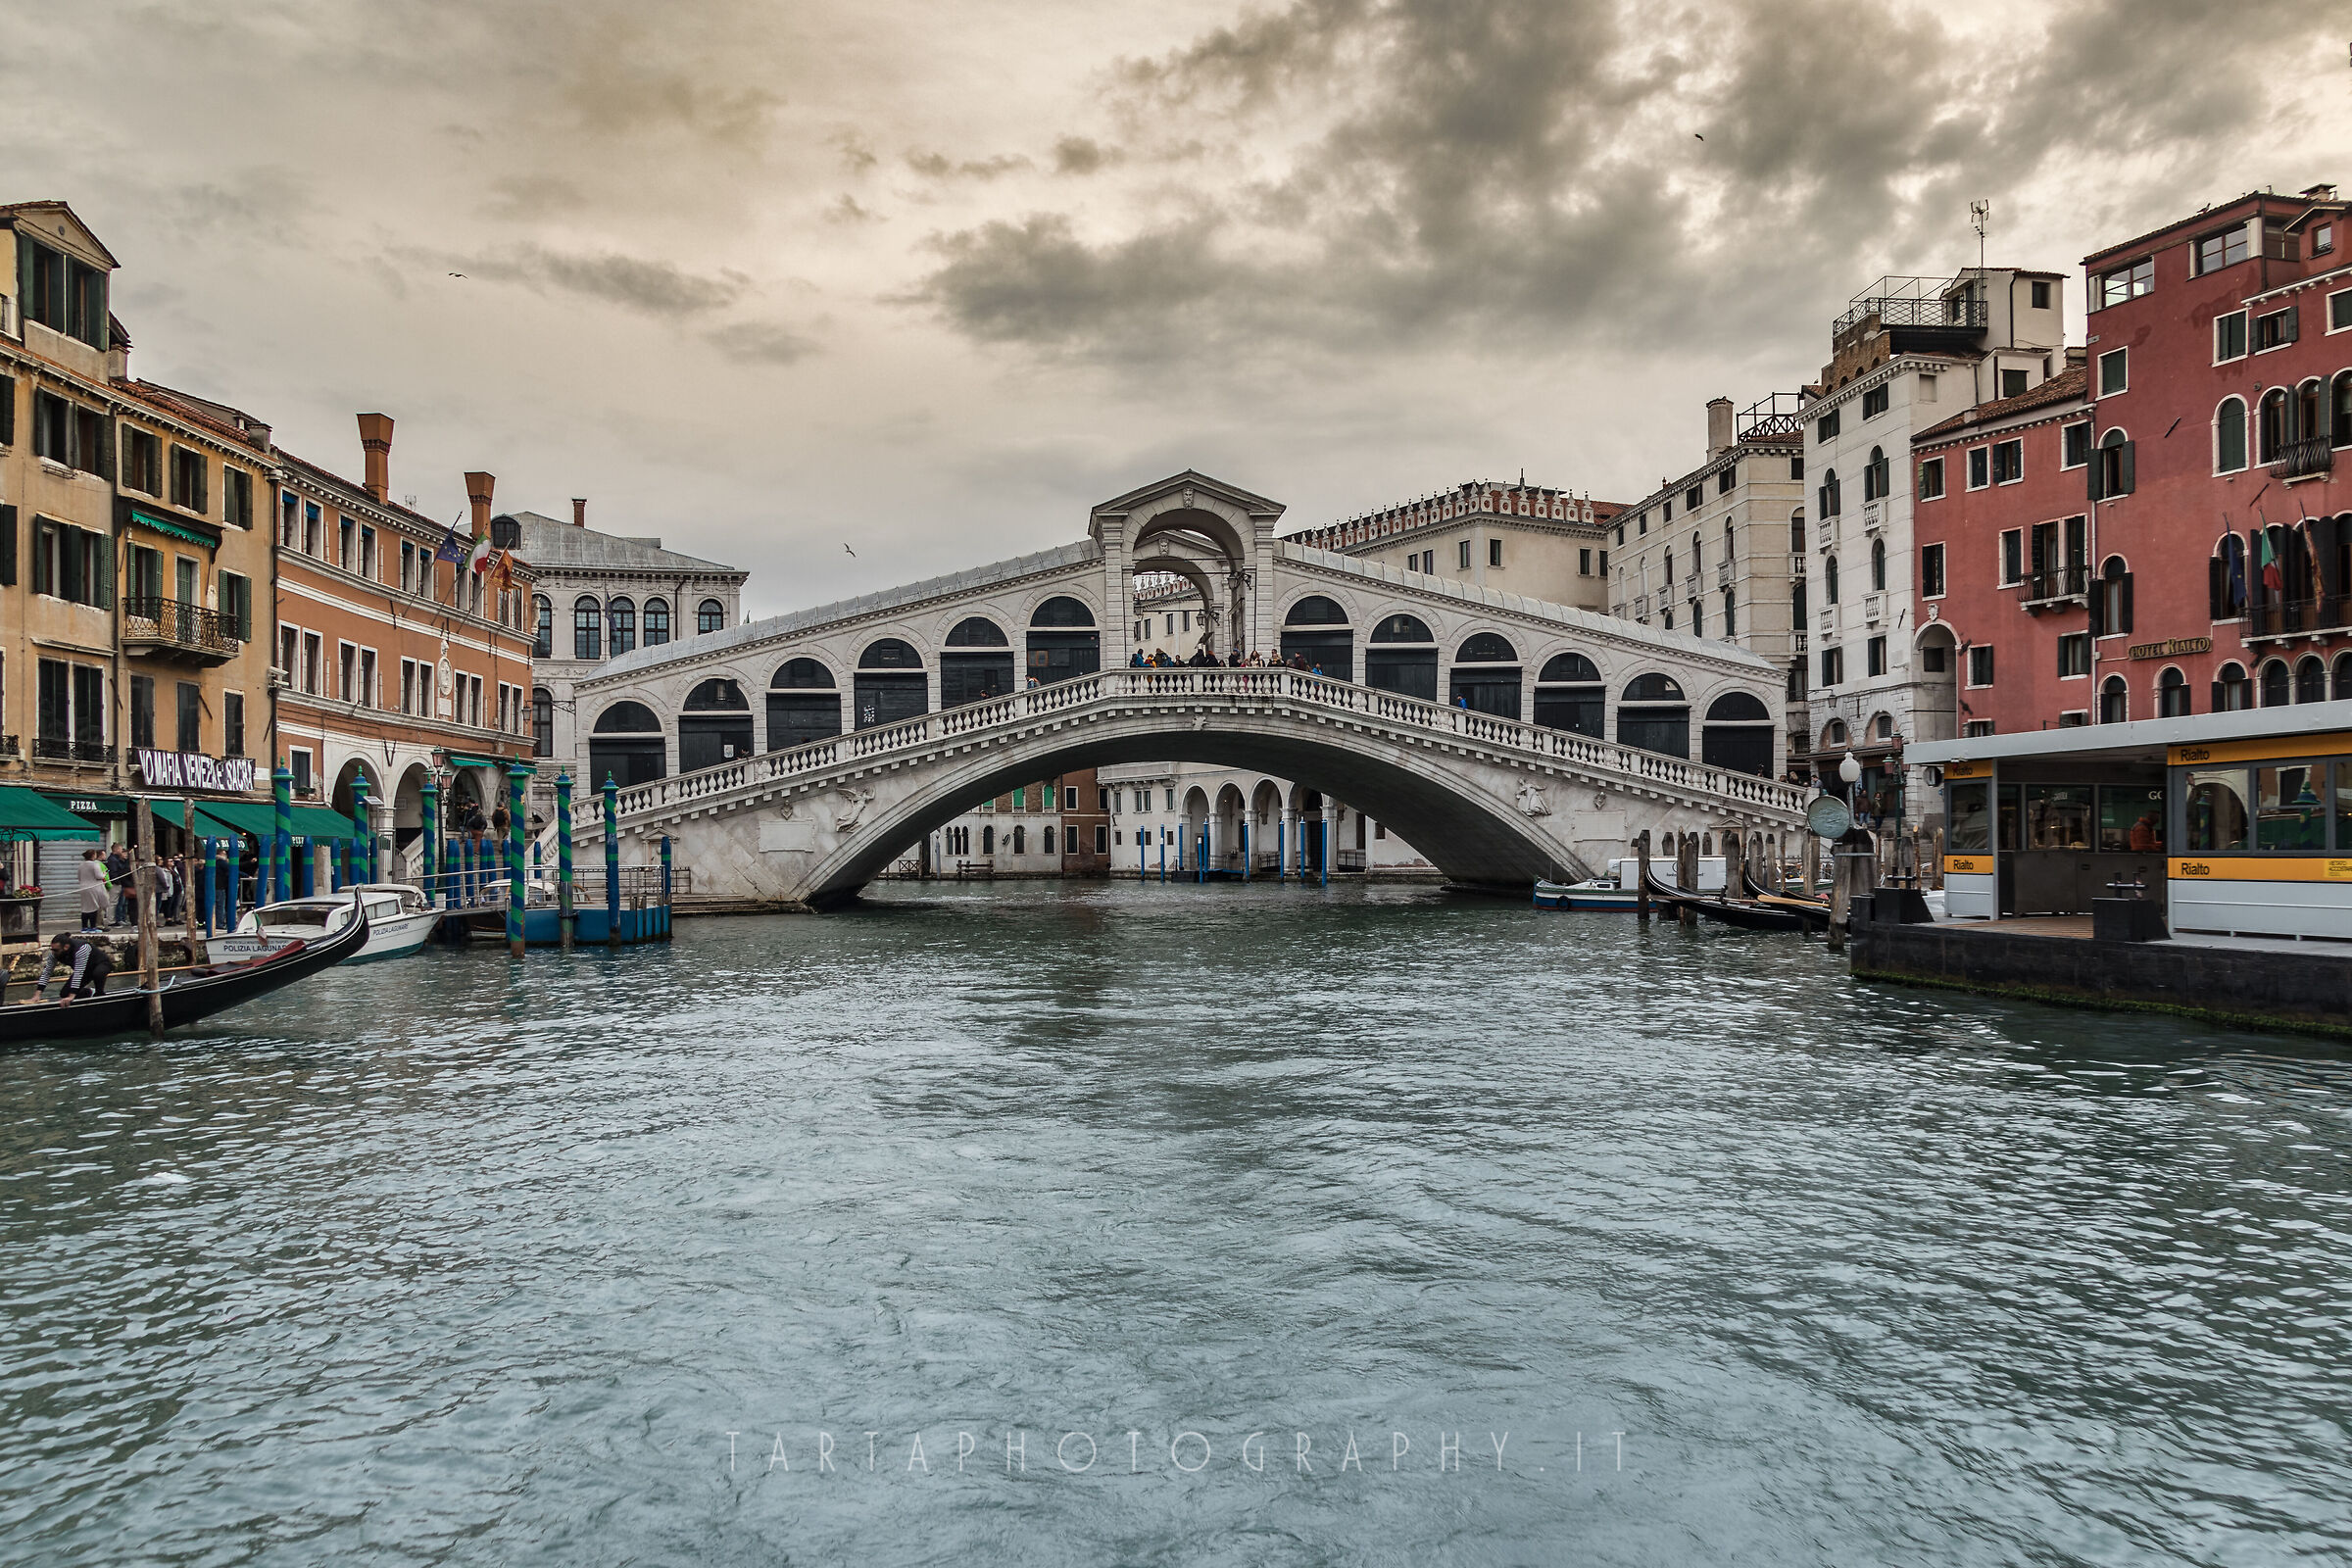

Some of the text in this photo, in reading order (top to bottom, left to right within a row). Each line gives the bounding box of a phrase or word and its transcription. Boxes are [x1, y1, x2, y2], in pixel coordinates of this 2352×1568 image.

[2132, 638, 2207, 658] HOTEL RIALTO
[2180, 749, 2210, 761] Rialto
[154, 751, 183, 786] MAFIA
[71, 801, 97, 810] PIZZA
[1953, 859, 1974, 870] Rialto
[2180, 862, 2210, 876] Rialto
[373, 927, 388, 937] POLIZIA
